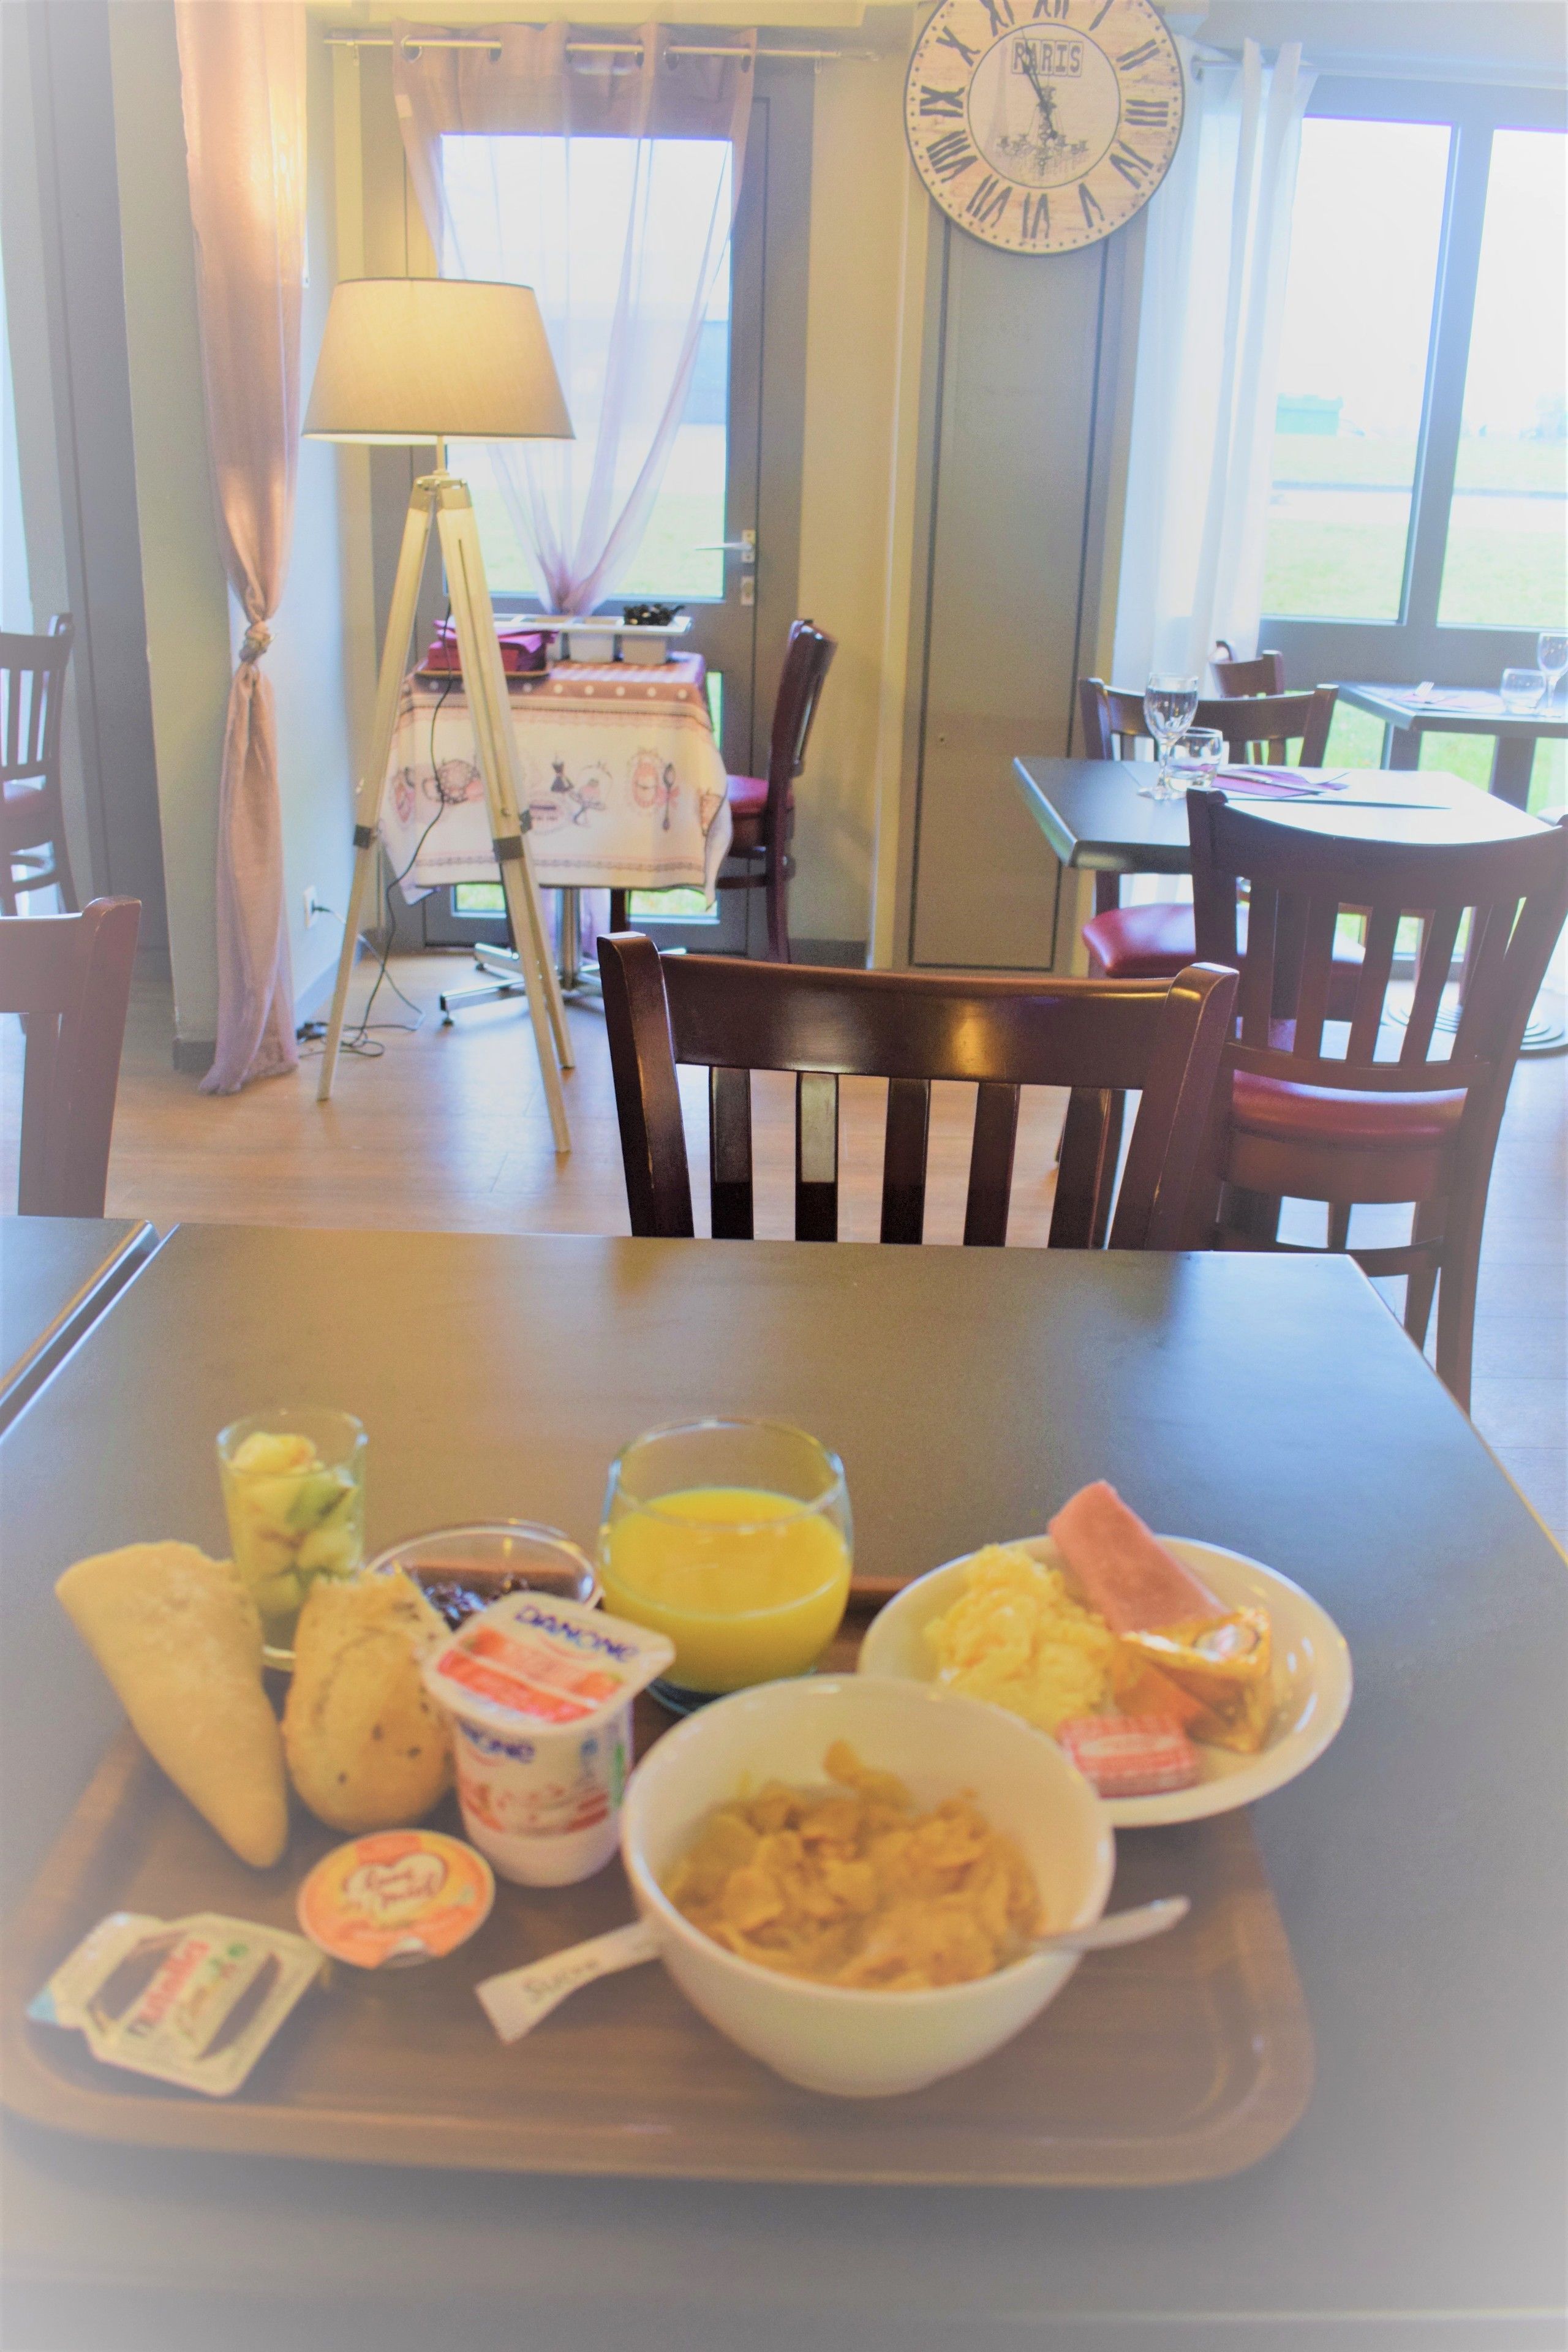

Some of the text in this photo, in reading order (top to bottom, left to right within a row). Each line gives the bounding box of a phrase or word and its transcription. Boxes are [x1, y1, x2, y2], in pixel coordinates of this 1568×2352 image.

[935, 25, 981, 67] X
[1014, 41, 1082, 74] PARIS
[1115, 38, 1161, 72] II
[919, 85, 966, 118] IX
[1124, 99, 1169, 127] III
[925, 129, 979, 183] VIII
[1109, 139, 1155, 190] IV
[965, 173, 1013, 228] VII
[1022, 191, 1050, 239] VI
[1079, 182, 1105, 229] V
[514, 1603, 640, 1663] DANONE
